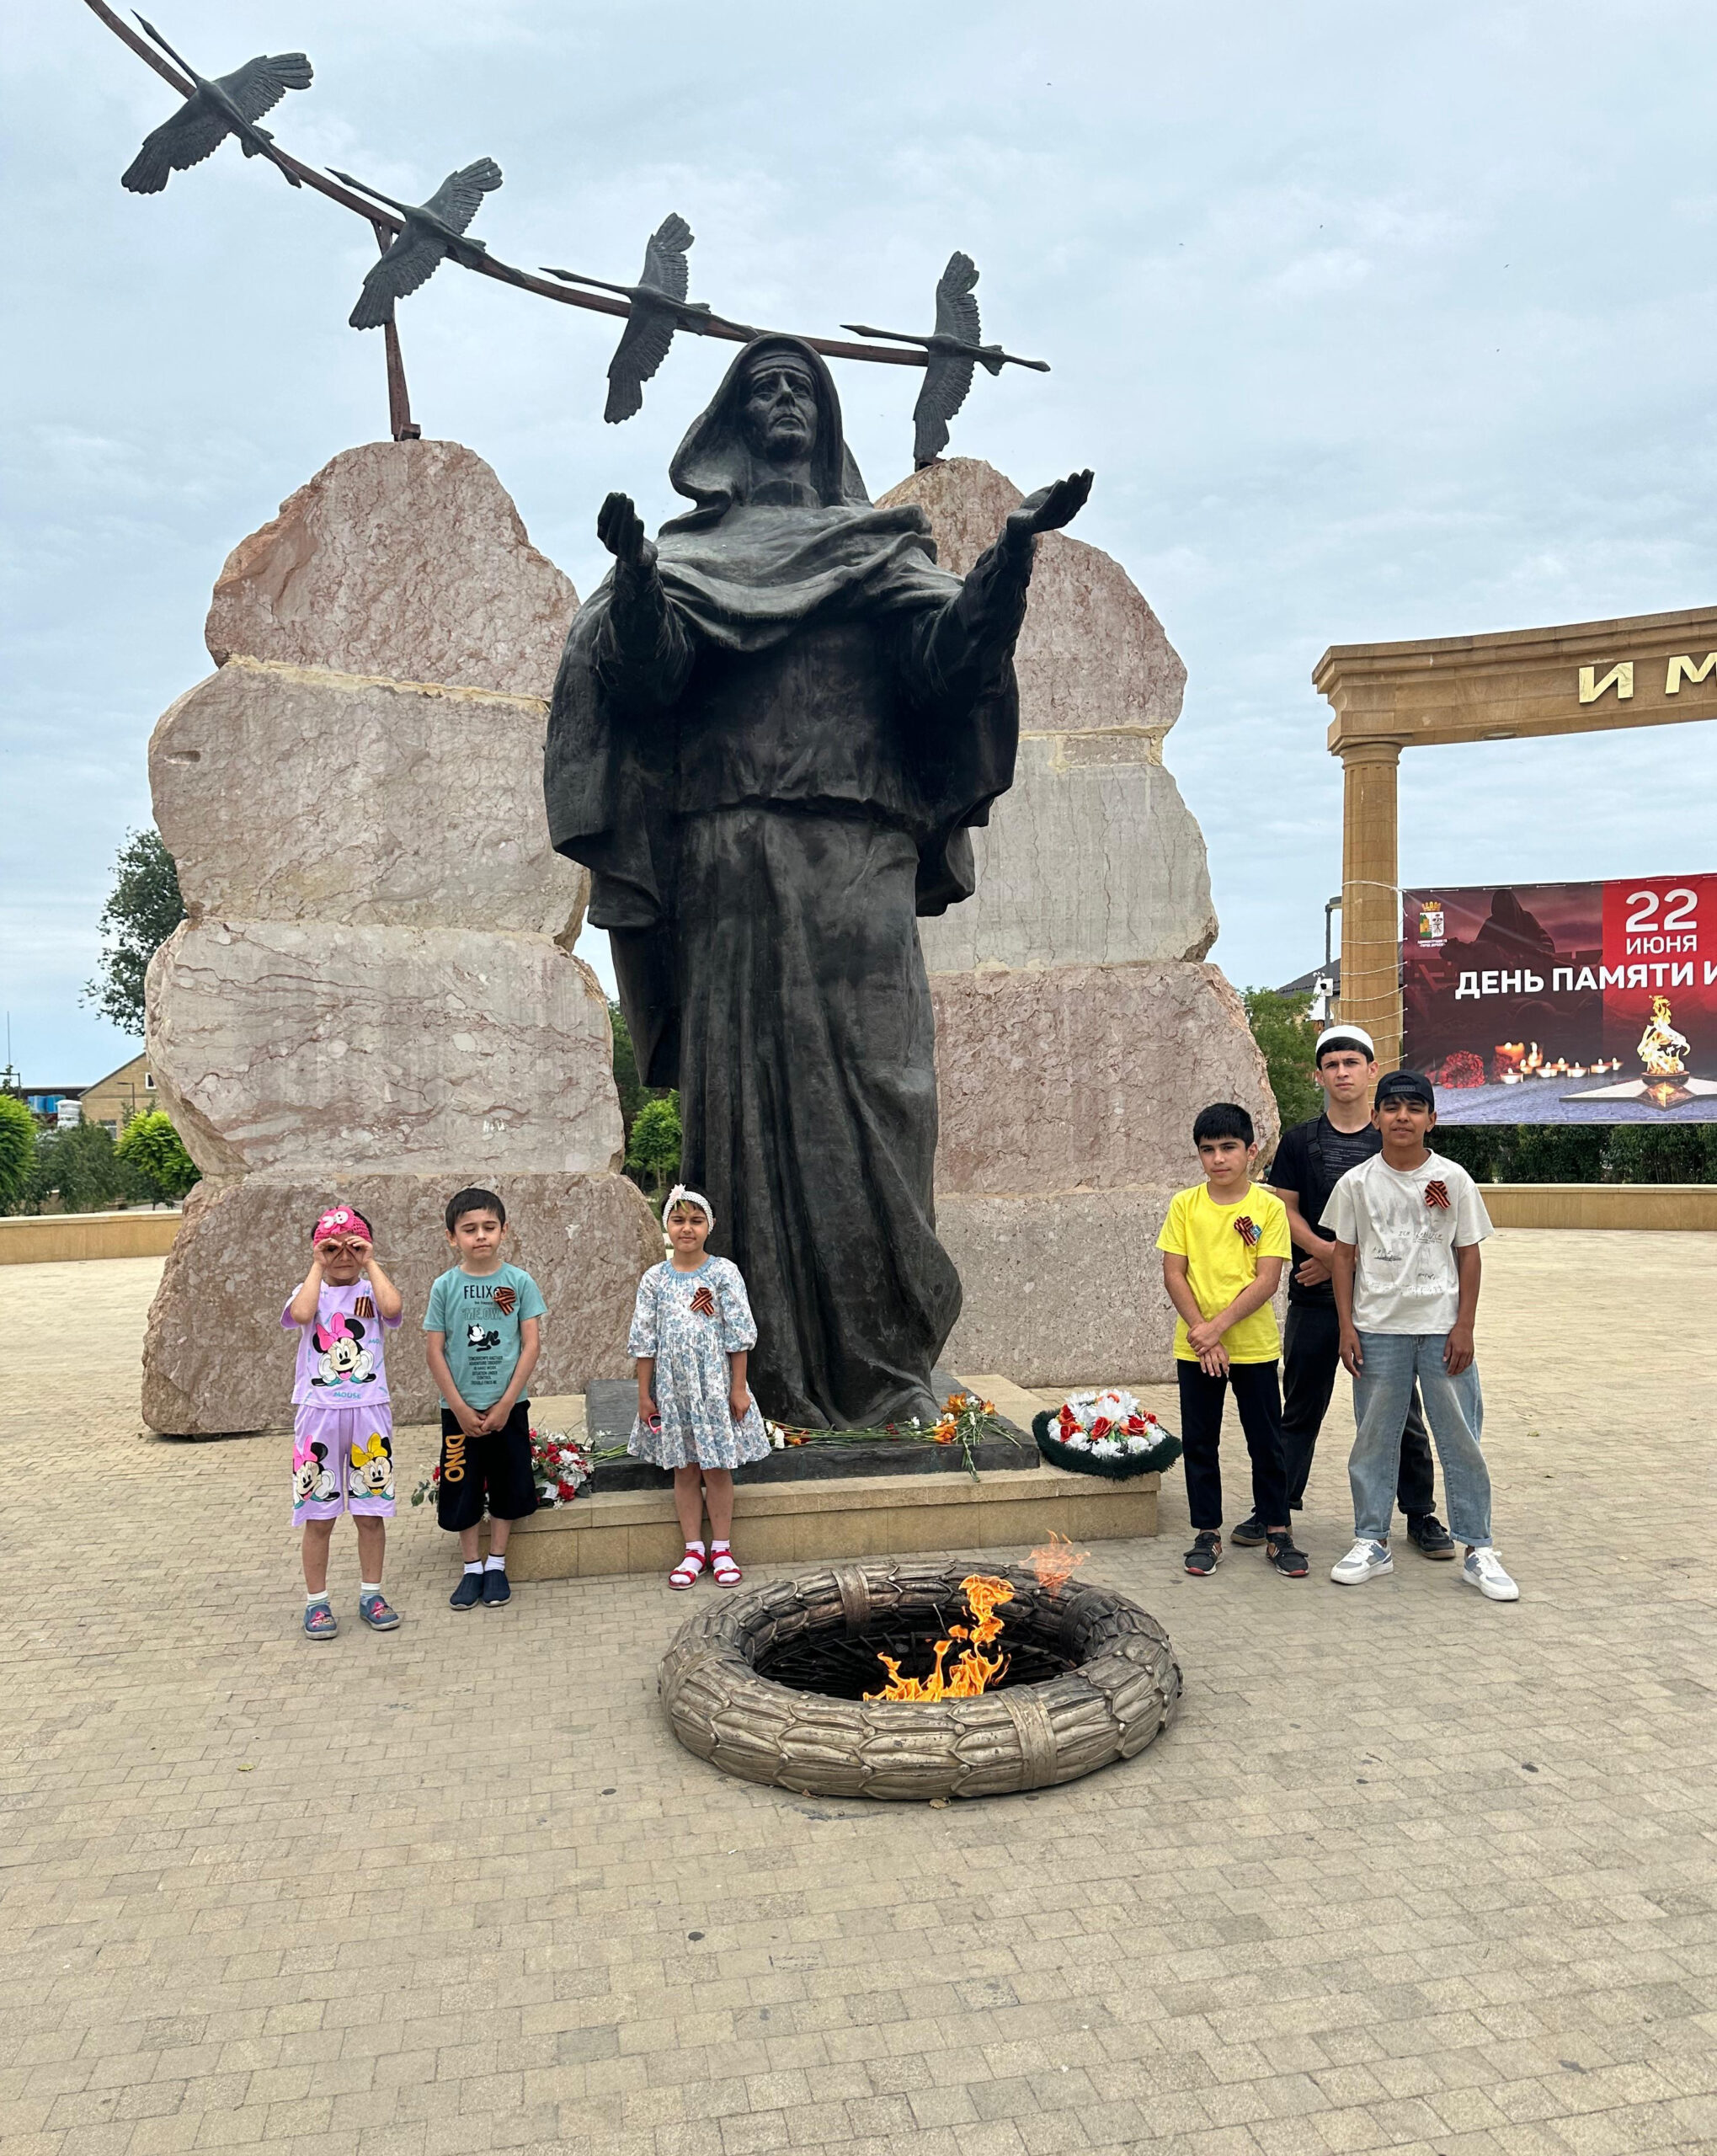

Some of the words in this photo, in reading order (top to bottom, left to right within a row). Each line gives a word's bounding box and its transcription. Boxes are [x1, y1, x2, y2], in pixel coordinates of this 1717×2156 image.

[1625, 889, 1698, 932] 22
[1626, 934, 1698, 955] ИЮНЯ
[1455, 969, 1544, 1000] ДЕНЬ
[1553, 962, 1694, 991] ПАМЯТИ
[463, 1284, 493, 1299] FELIX
[444, 1433, 467, 1482] DINO
